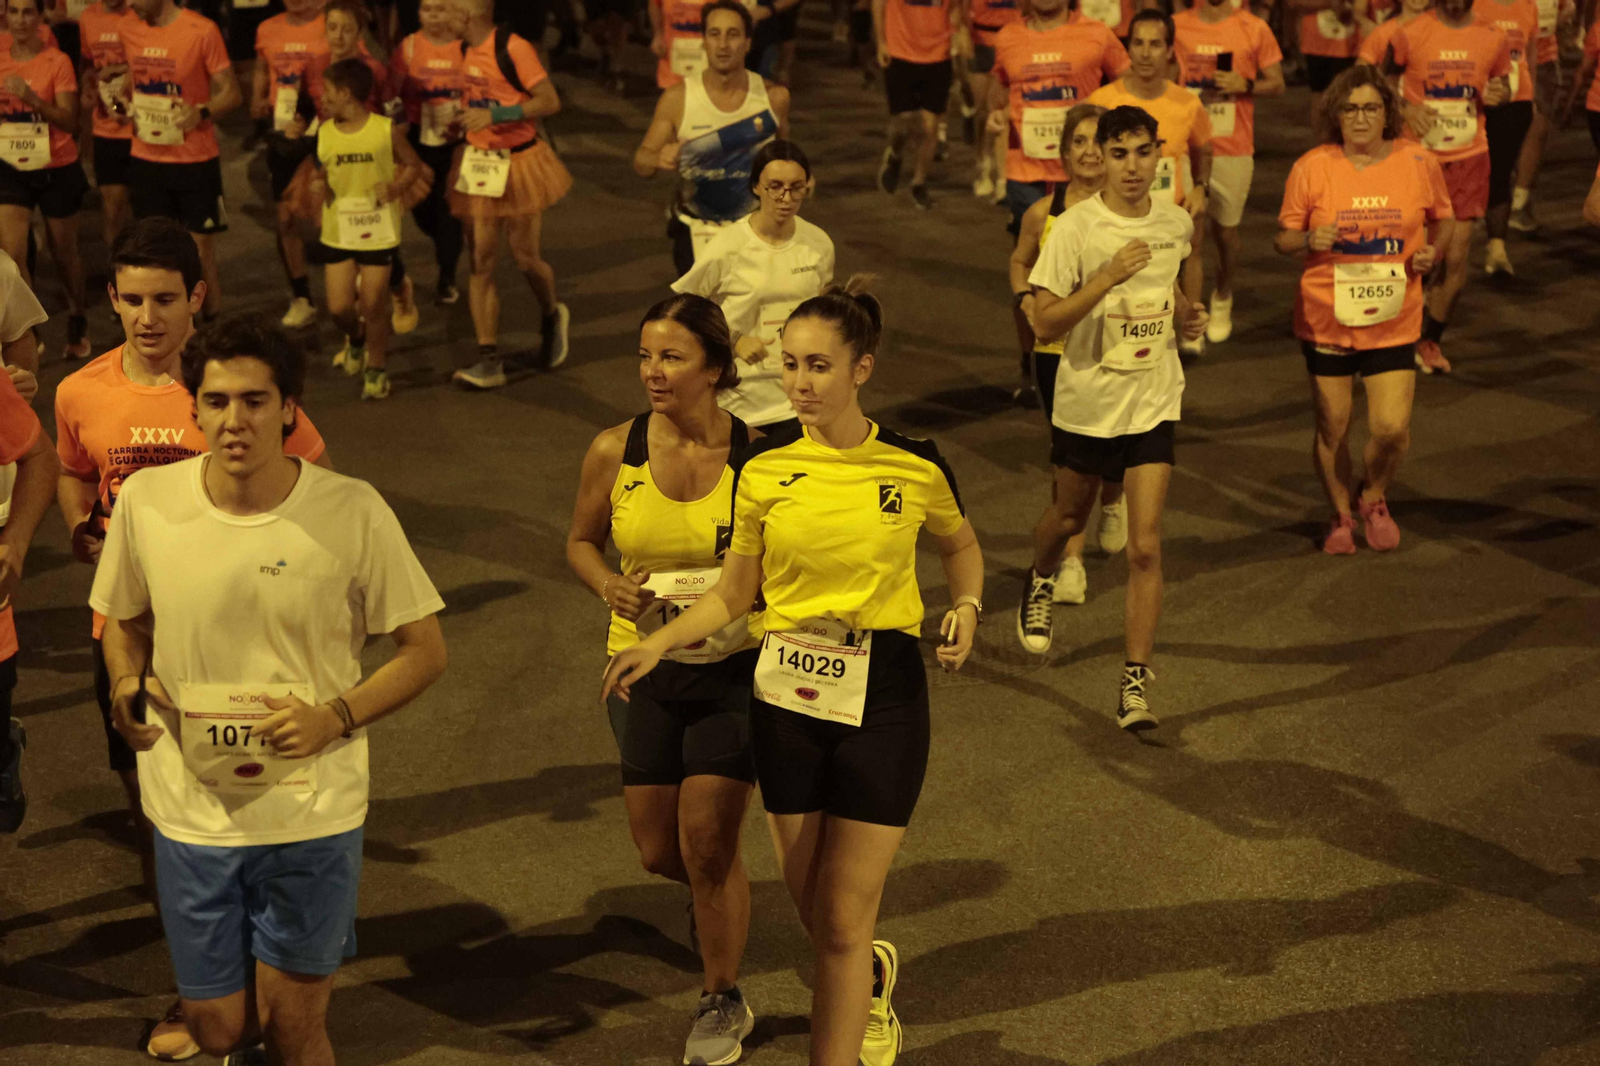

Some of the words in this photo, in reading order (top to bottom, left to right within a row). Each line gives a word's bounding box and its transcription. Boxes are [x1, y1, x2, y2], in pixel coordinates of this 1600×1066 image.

[9, 140, 36, 150] 7809
[1351, 196, 1389, 209] XXXV
[1349, 285, 1394, 299] 12655
[1120, 320, 1164, 338] 14902
[129, 426, 185, 445] XXXV
[107, 446, 149, 455] CARRERA
[153, 447, 202, 456] NOCTURNA
[115, 455, 185, 466] GUADALQU
[711, 517, 730, 526] Vida
[657, 605, 692, 624] 11
[777, 645, 846, 678] 14029
